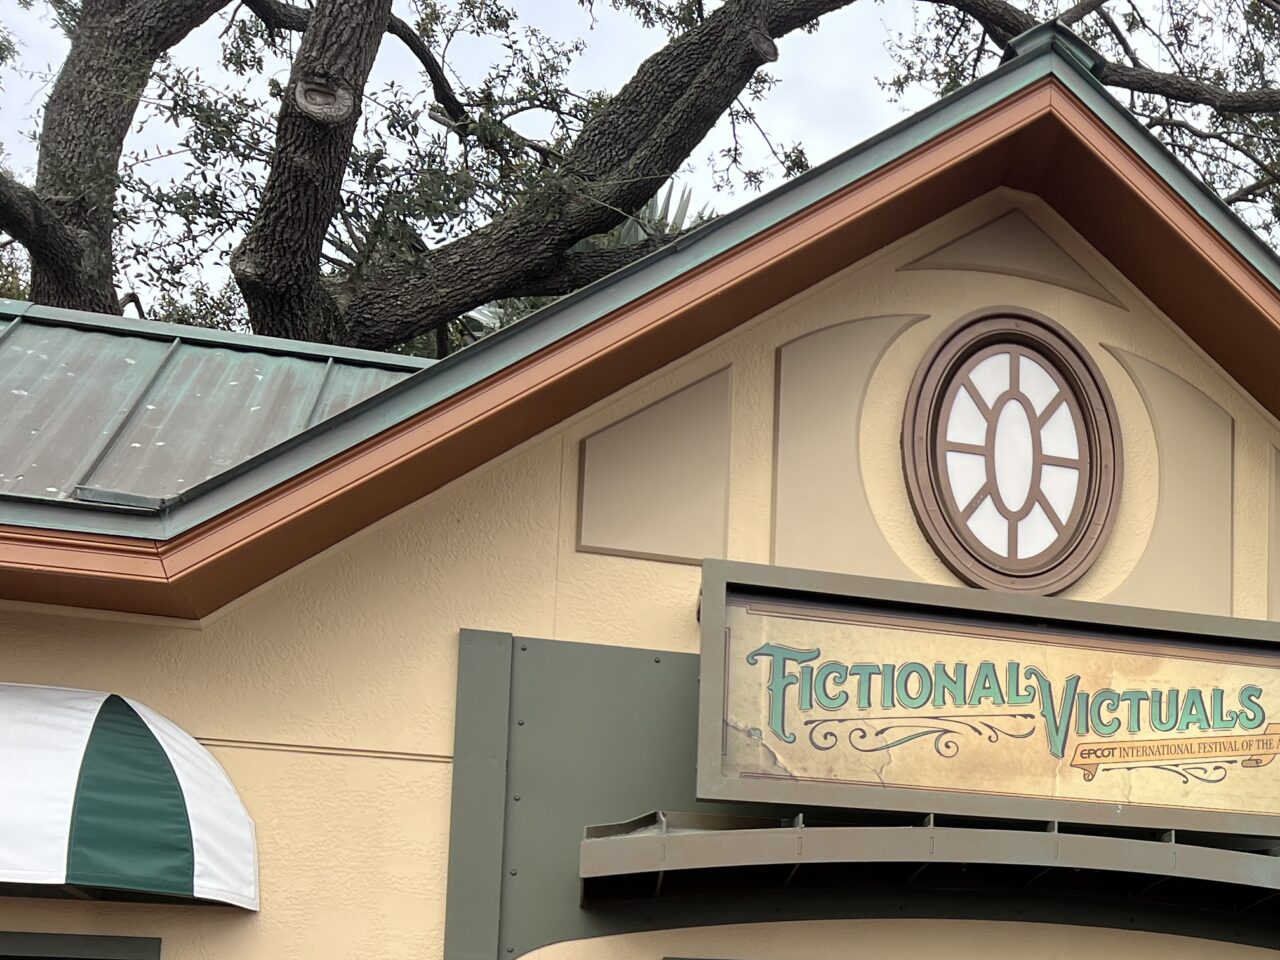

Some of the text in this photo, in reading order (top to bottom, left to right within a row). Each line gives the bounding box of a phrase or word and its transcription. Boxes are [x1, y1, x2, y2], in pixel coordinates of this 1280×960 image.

[746, 641, 1267, 760] FICTIONAL VICTUALS
[1079, 747, 1118, 760] EPCOT
[1119, 743, 1195, 758] INTERNATIONAL
[1197, 740, 1240, 755] FESTIVAL
[1241, 739, 1254, 751] OF
[1256, 738, 1275, 750] THE
